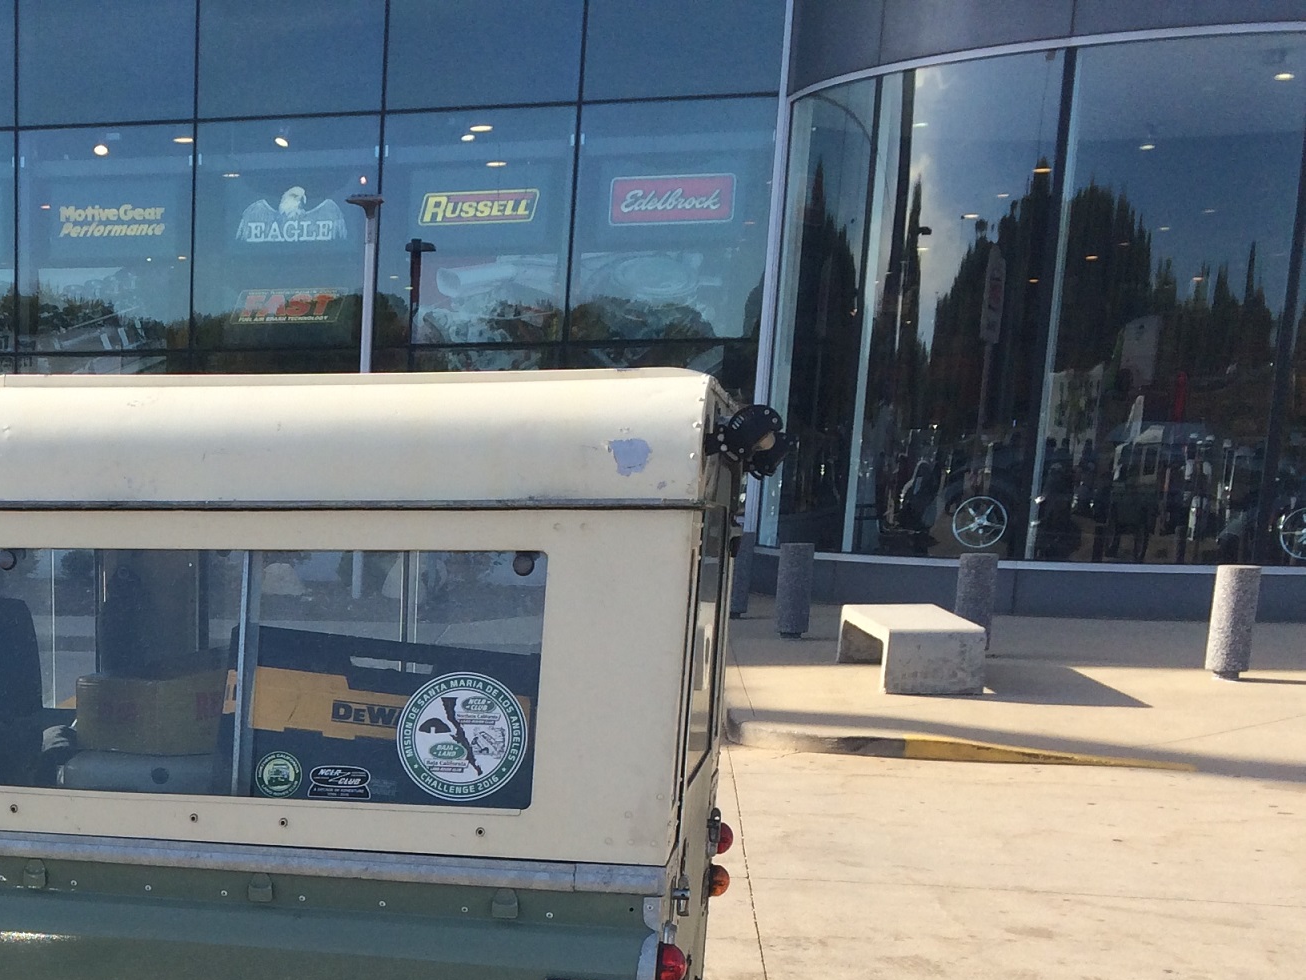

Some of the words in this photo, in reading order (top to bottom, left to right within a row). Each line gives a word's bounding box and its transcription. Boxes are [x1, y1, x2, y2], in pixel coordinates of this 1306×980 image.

[423, 196, 530, 222] RUSSELL
[620, 188, 720, 212] Edelbrock
[59, 223, 165, 237] Performance
[246, 220, 334, 242] EAGLE
[241, 294, 336, 317] FAST
[449, 679, 484, 690] MARIA
[485, 685, 500, 697] DE
[416, 683, 448, 710] SANTA
[498, 694, 515, 715] LOS
[408, 706, 420, 720] DE
[403, 721, 414, 758] MISION
[507, 715, 521, 762] ANGELES
[337, 777, 362, 785] CLUB
[420, 772, 475, 794] CHALLENGE
[477, 774, 500, 791] 2016
